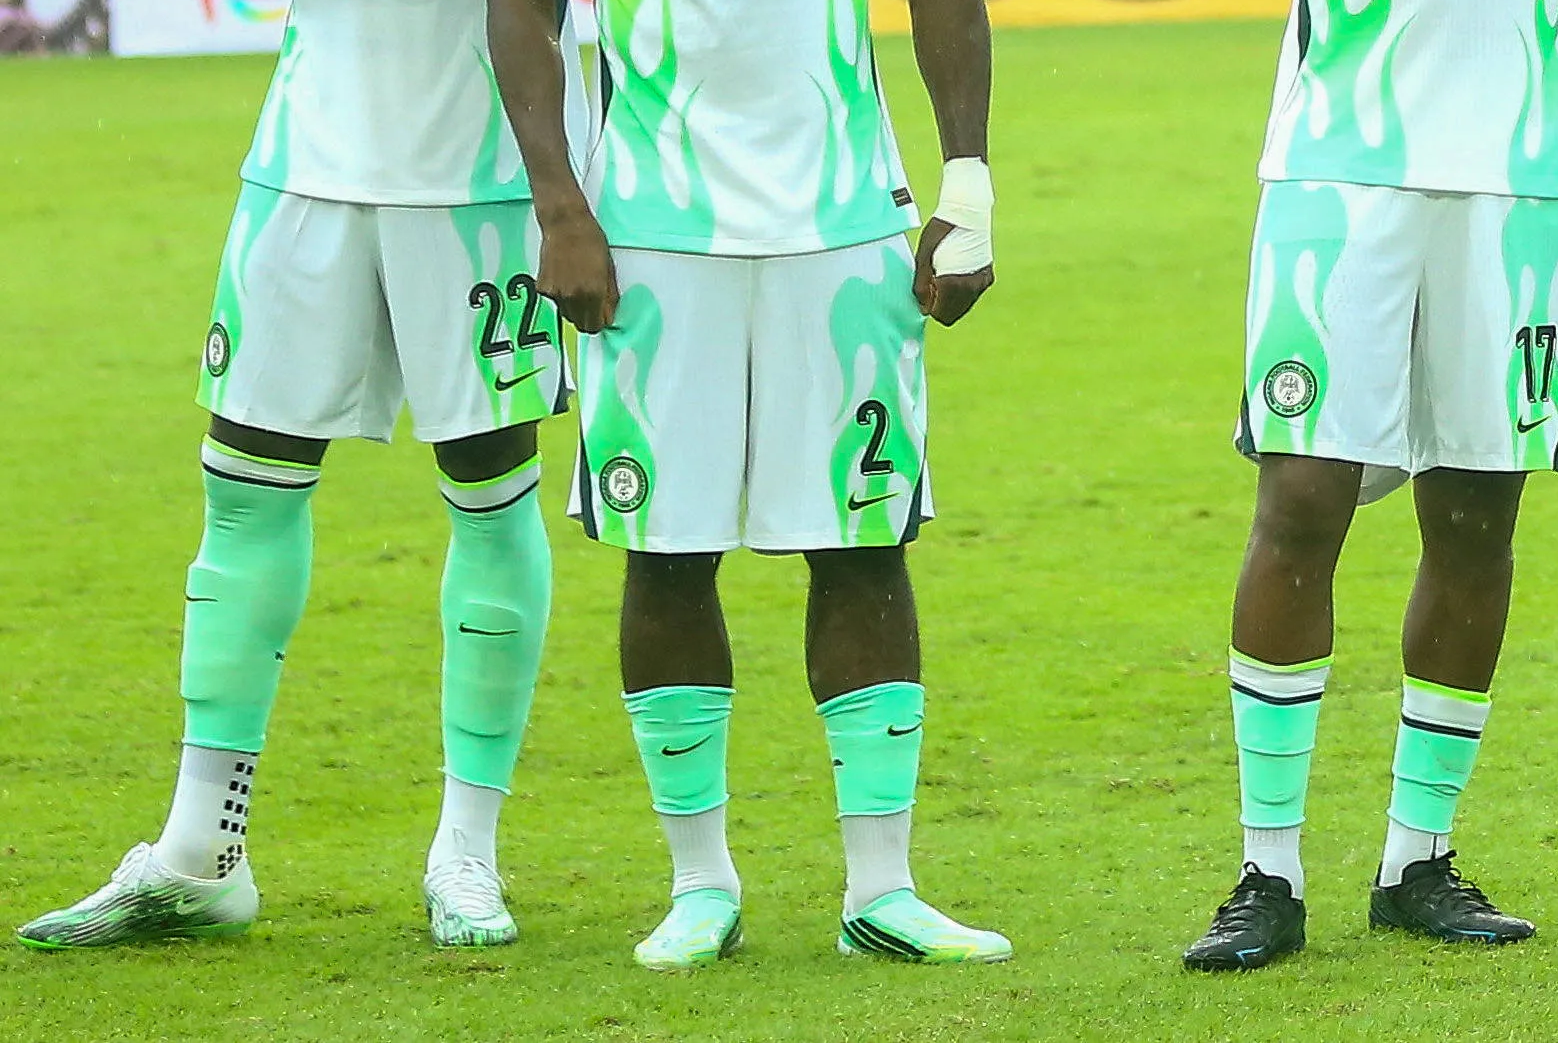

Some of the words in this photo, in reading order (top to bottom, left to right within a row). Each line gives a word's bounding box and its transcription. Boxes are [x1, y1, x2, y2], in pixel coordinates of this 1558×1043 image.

[469, 273, 552, 358] 22
[1515, 324, 1558, 404] 17
[856, 399, 895, 476] 2
